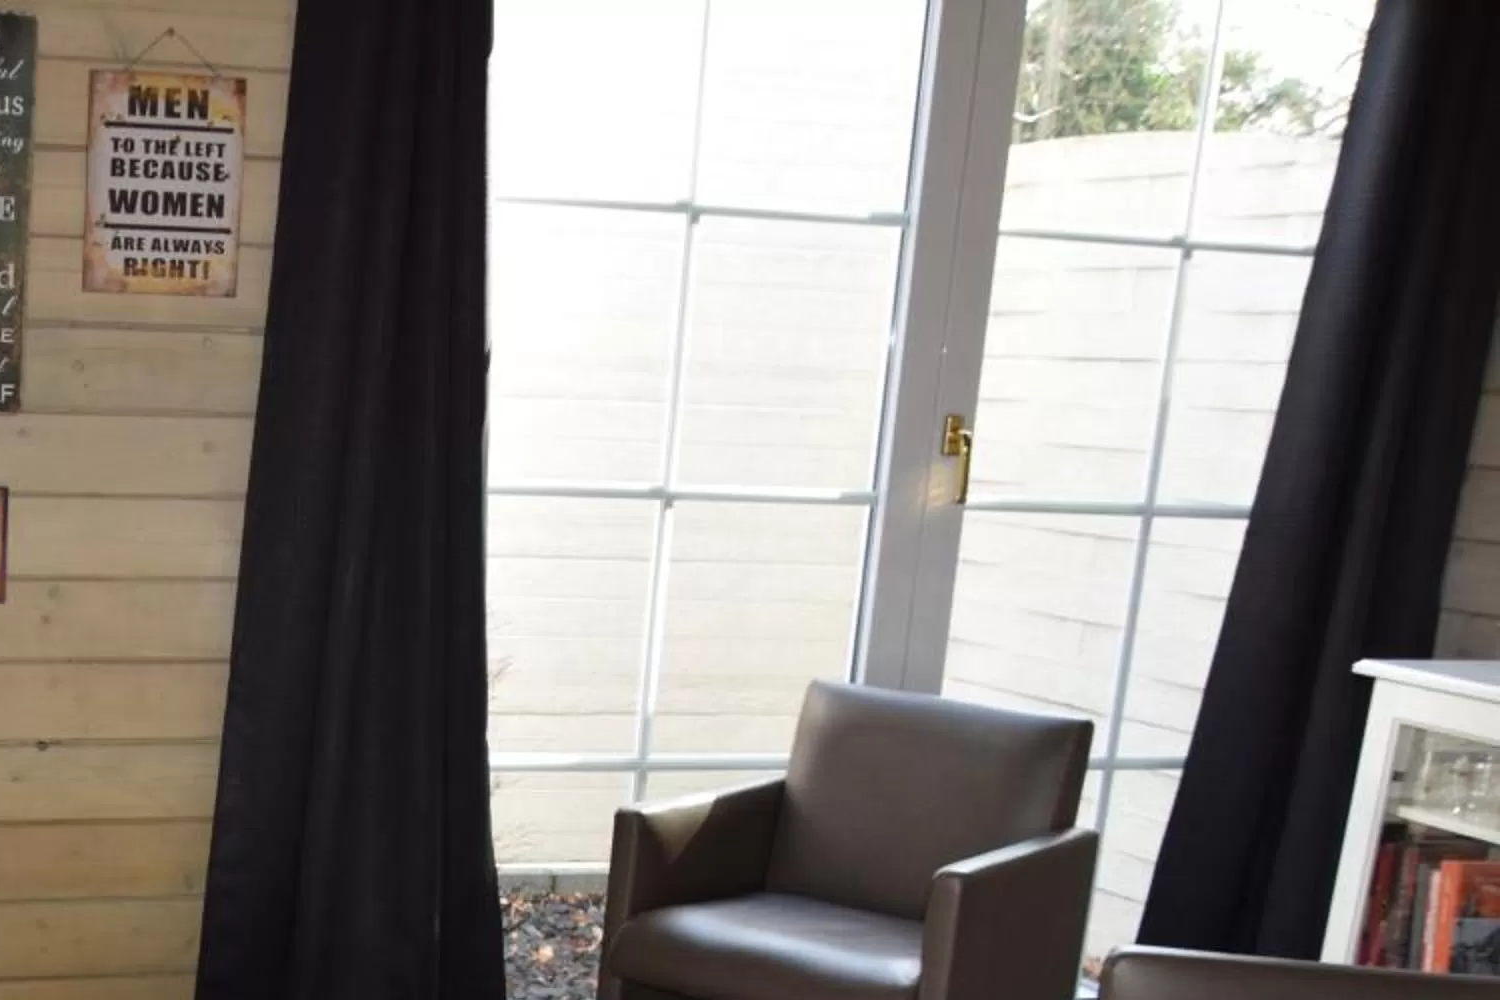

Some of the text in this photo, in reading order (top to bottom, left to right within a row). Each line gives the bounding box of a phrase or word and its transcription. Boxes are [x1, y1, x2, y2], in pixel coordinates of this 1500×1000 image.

[128, 84, 209, 120] MEN
[110, 137, 227, 158] TO THE LEFT
[110, 158, 228, 183] BECAUSE
[108, 188, 225, 218] WOMEN
[111, 236, 225, 255] ARE ALWAYS
[123, 257, 210, 280] RIGHT!
